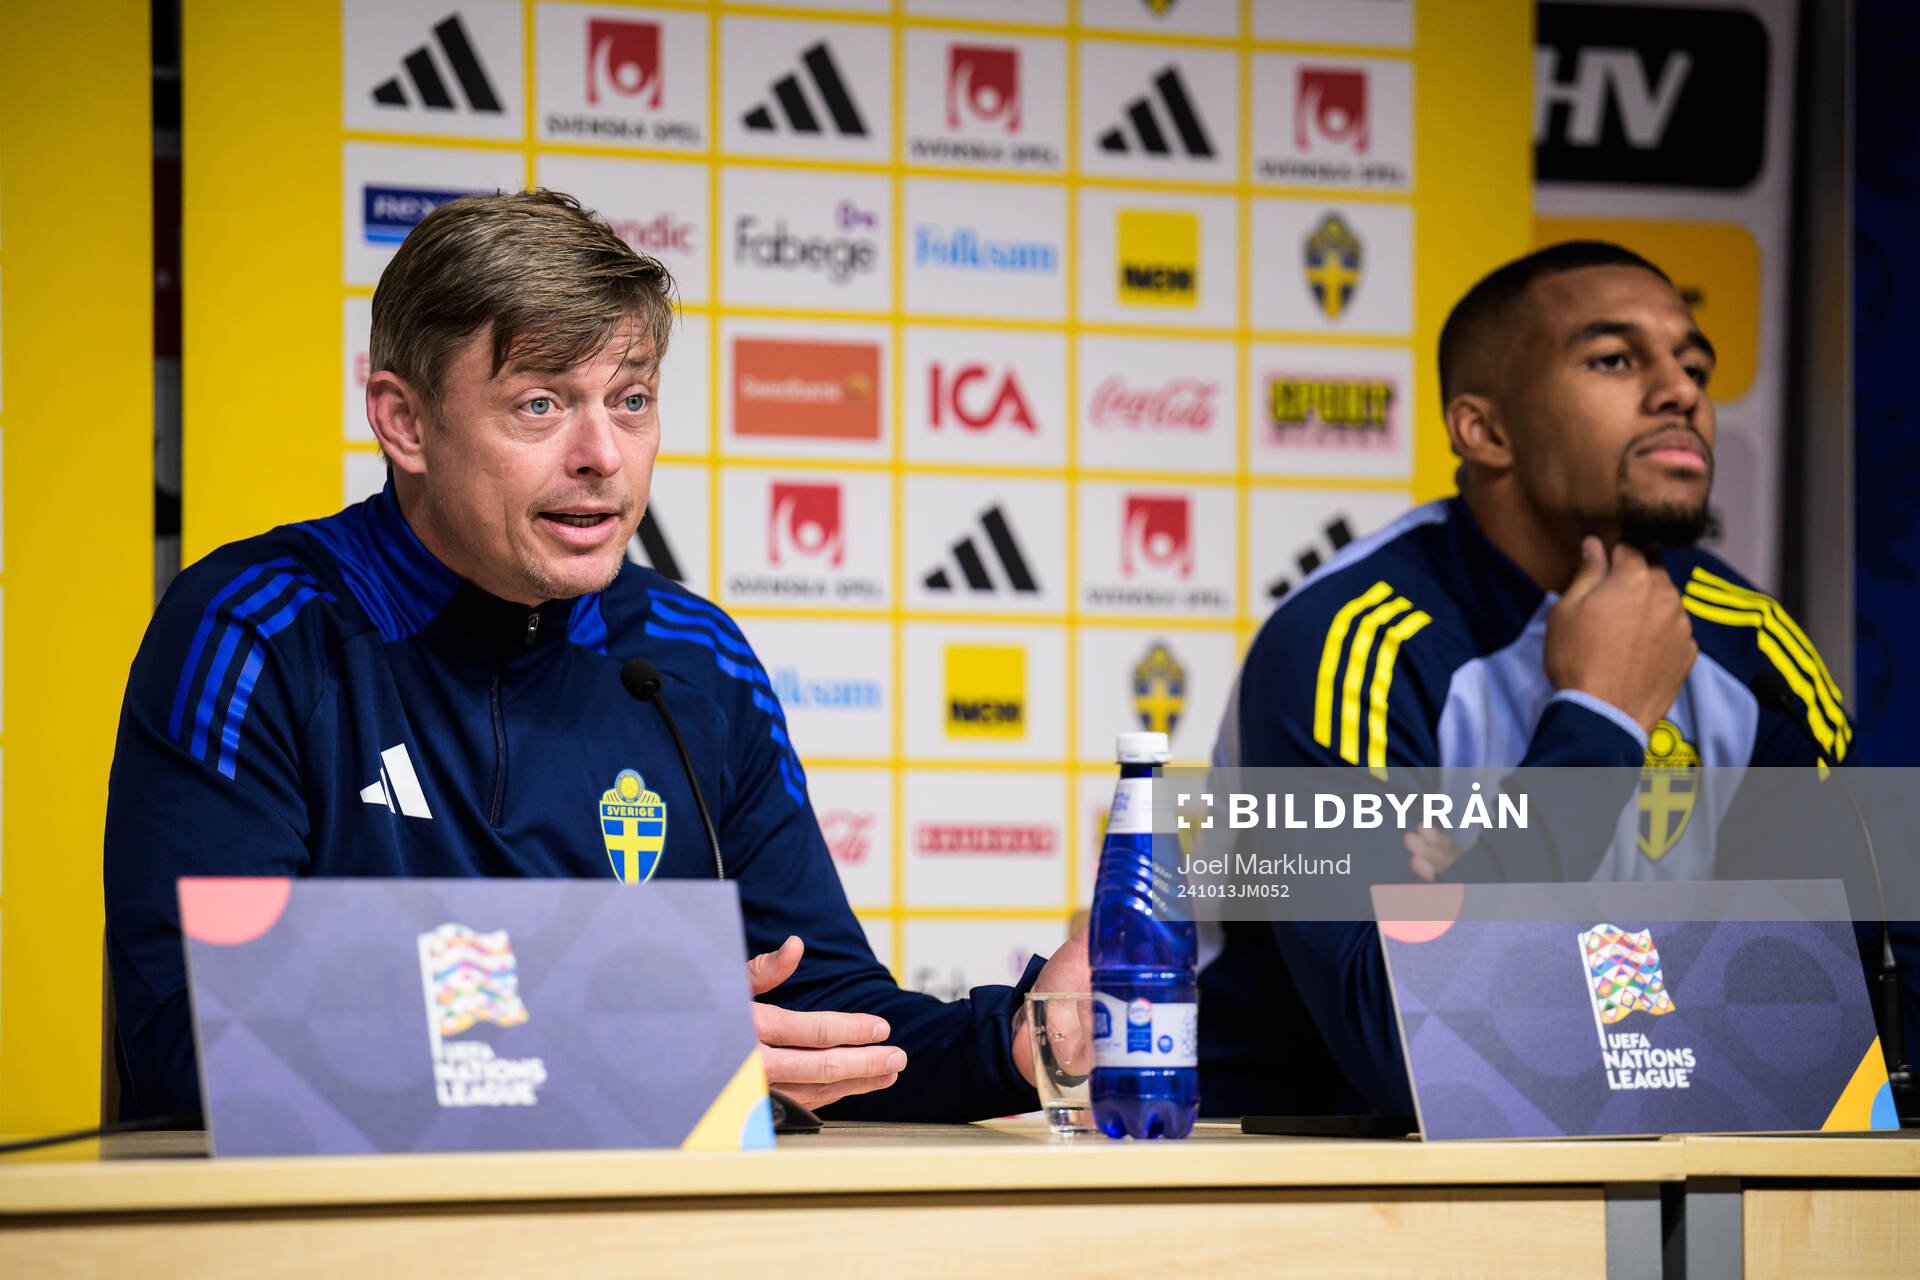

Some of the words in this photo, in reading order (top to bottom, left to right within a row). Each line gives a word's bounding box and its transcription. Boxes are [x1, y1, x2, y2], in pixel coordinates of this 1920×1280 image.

[736, 215, 878, 285] Fabege
[928, 361, 1039, 434] ICA
[607, 806, 655, 817] SVERIGE
[1607, 1033, 1651, 1049] UEFA
[1602, 1048, 1696, 1070] NATIONS
[1607, 1069, 1690, 1090] LEAGUE
